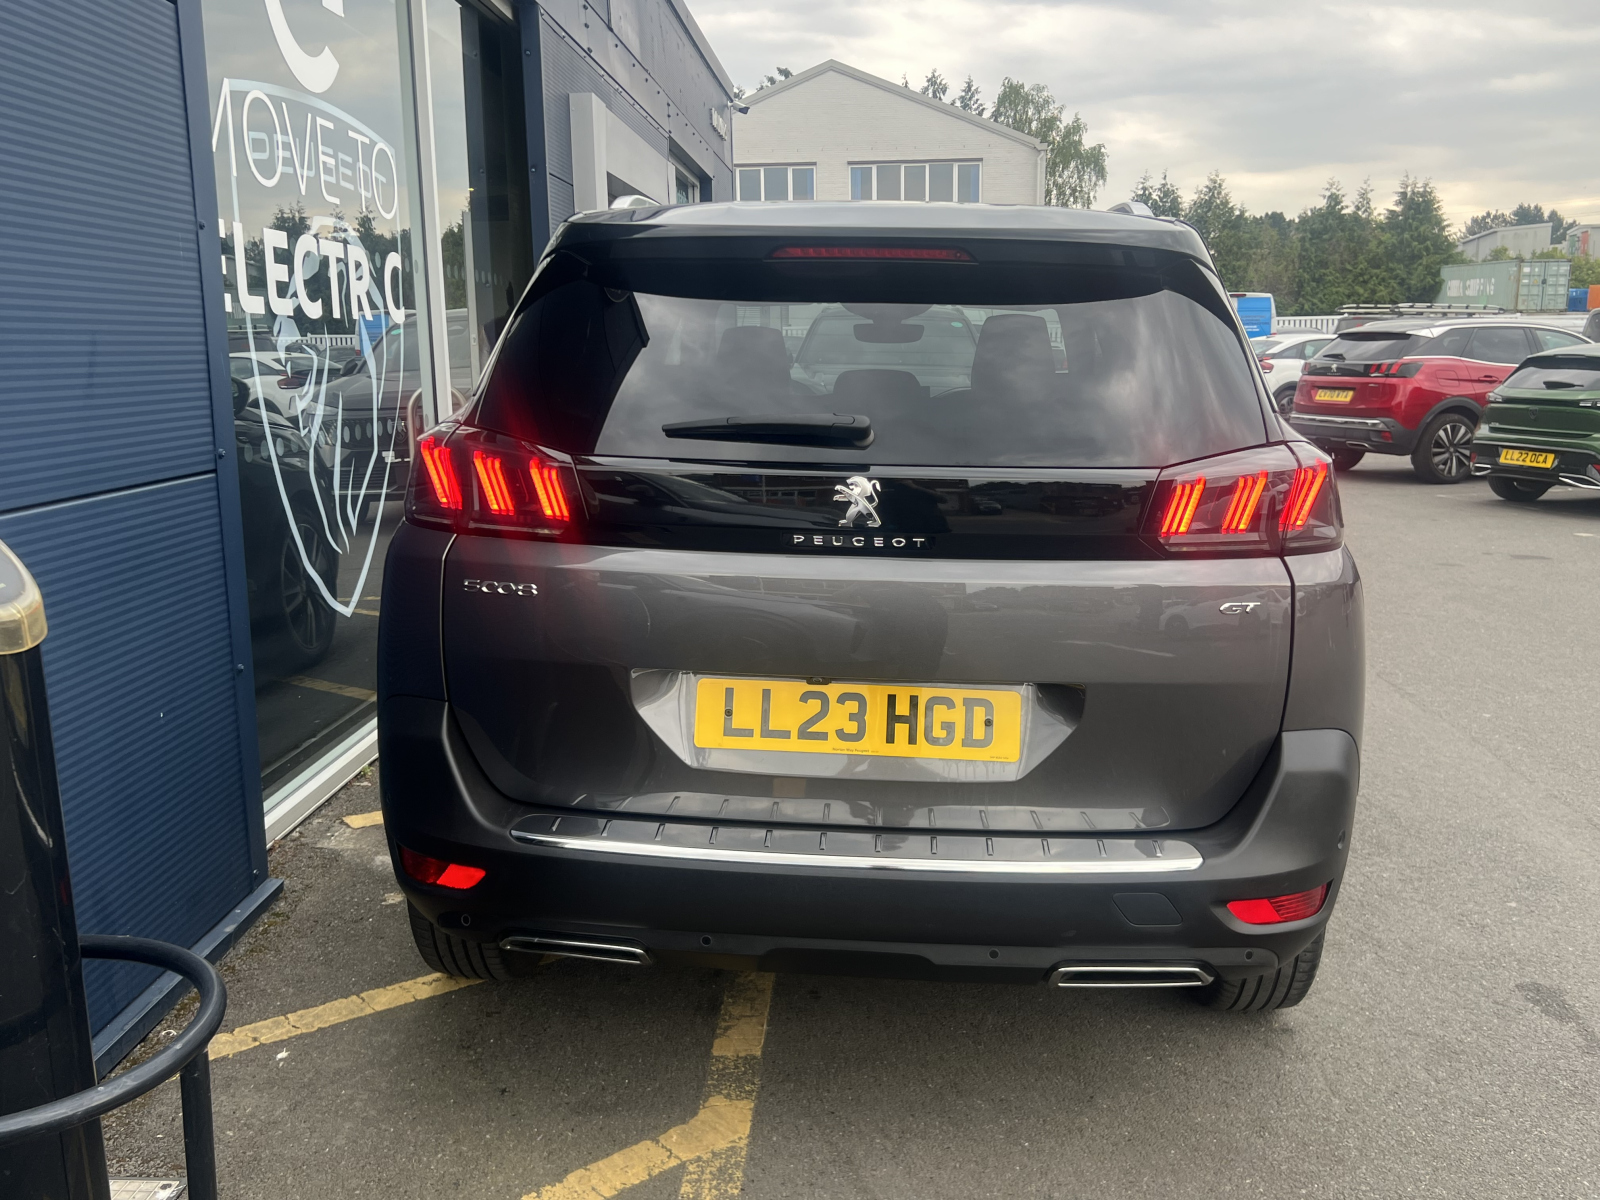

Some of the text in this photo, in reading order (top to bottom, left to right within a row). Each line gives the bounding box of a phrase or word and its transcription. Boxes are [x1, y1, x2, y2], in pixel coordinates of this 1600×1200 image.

[248, 131, 386, 206] PEUGEOT
[348, 130, 398, 220] TO
[1504, 449, 1549, 465] LL22 OCA
[793, 534, 926, 548] PEUGEOT
[463, 578, 539, 597] 5008
[1219, 601, 1262, 615] GT
[722, 686, 995, 749] LL23 HGD
